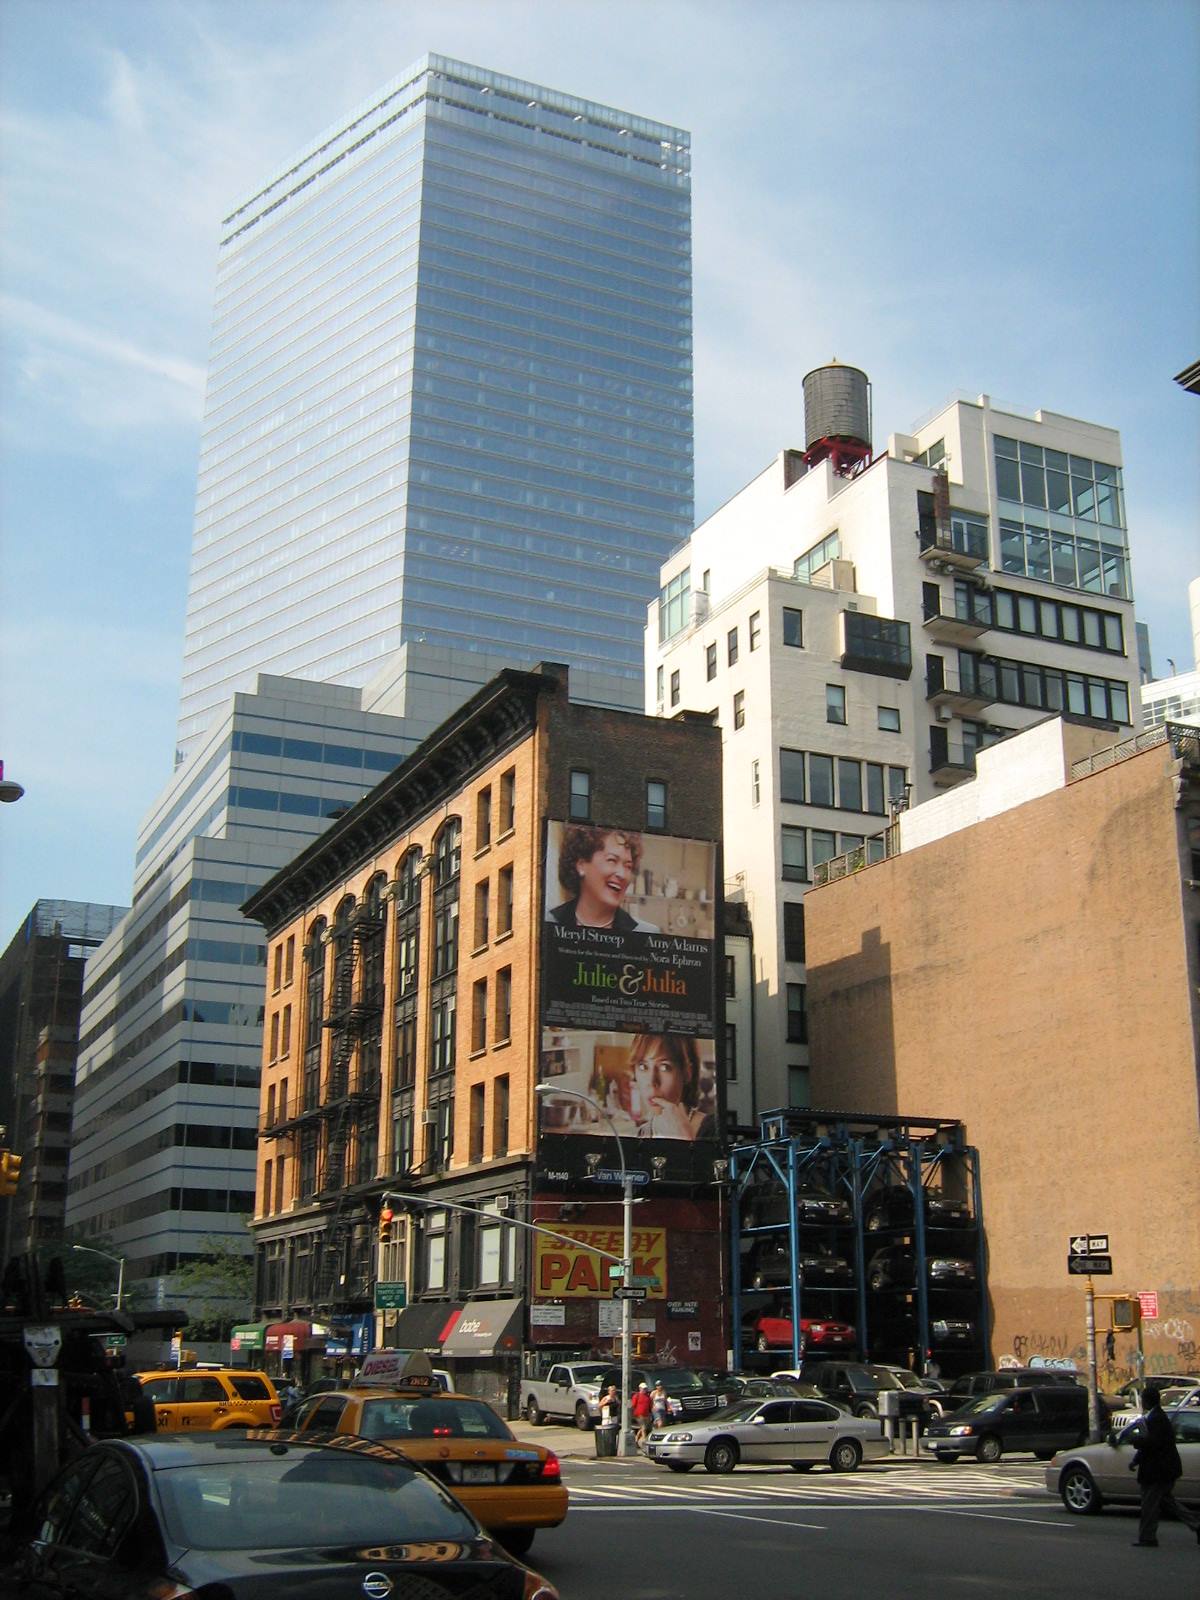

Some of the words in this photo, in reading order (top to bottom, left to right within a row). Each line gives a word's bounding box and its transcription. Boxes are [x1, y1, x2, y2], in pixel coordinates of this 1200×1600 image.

[554, 925, 586, 944] Meryl
[587, 929, 625, 948] Streep
[645, 935, 670, 953] Amy
[671, 939, 708, 953] Adams
[650, 952, 670, 964] Nora
[672, 954, 702, 969] Ephron
[573, 961, 618, 989] Julie
[618, 963, 645, 995] &
[642, 968, 687, 996] Julia
[597, 1172, 612, 1181] Van
[613, 1172, 645, 1182] Wner
[550, 1229, 661, 1253] SPEEDY
